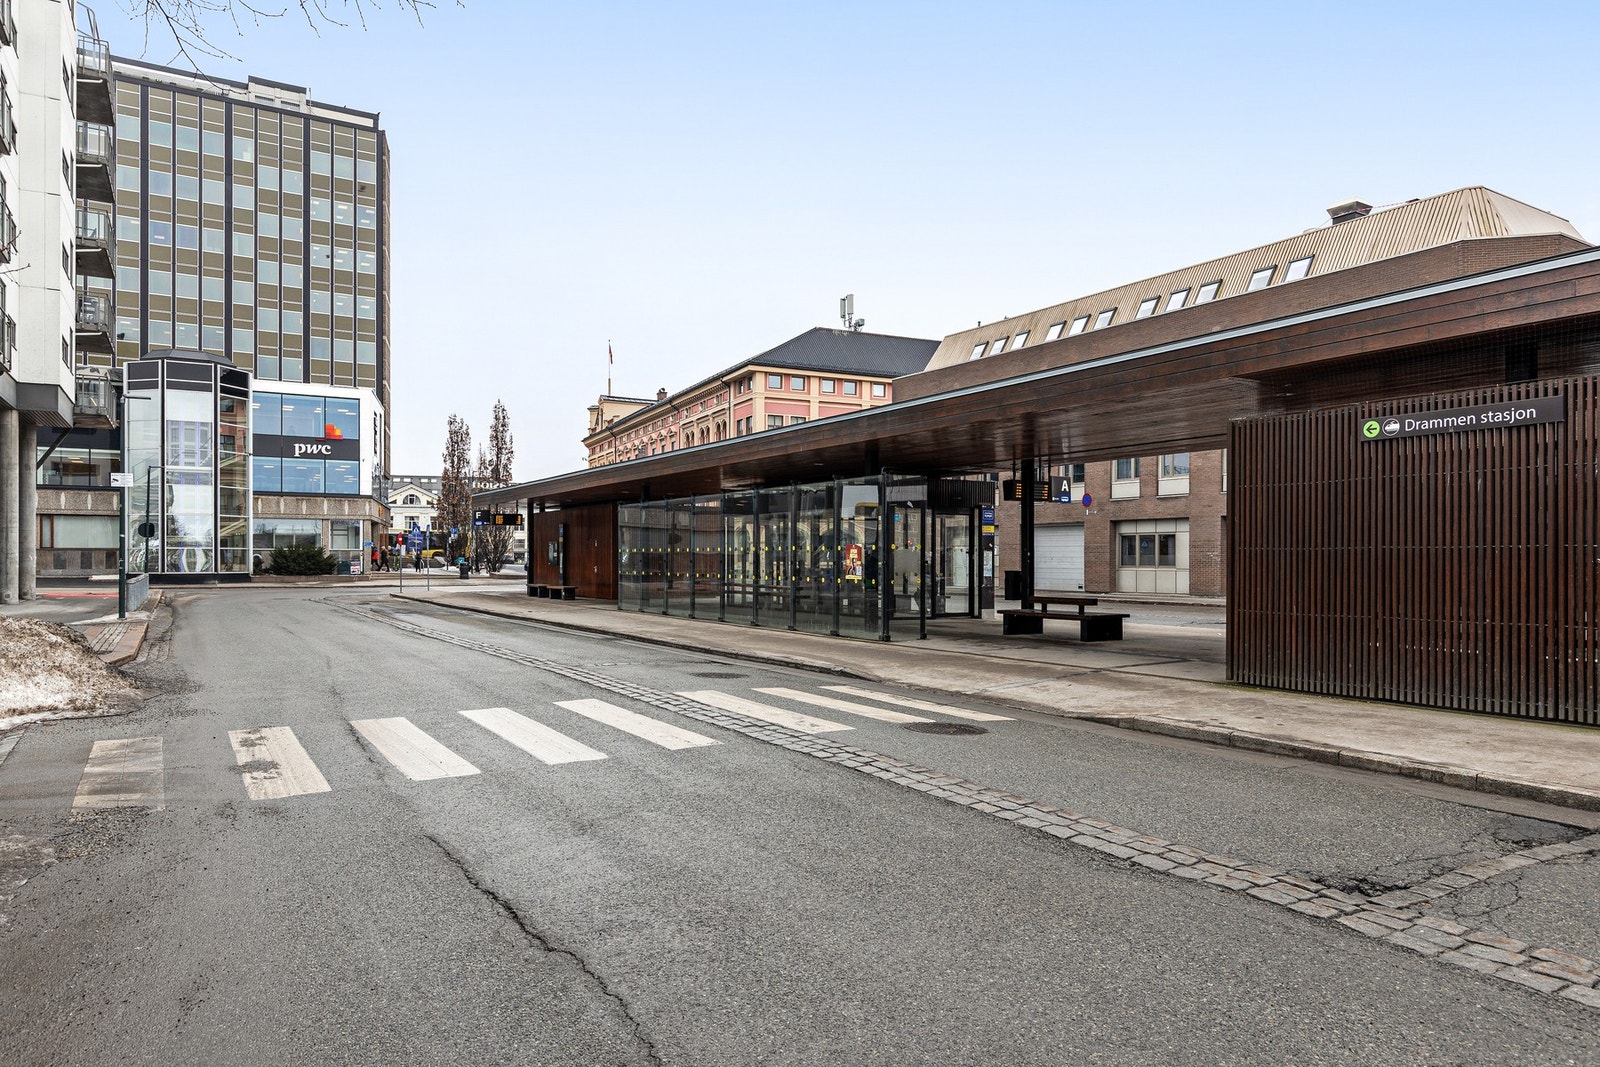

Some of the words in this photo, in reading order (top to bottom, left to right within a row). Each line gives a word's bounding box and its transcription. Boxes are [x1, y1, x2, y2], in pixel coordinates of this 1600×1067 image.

[1405, 414, 1476, 432] Drammen
[1480, 408, 1537, 424] stasjon
[293, 443, 332, 457] pwc
[1061, 480, 1070, 492] A
[475, 511, 482, 519] F
